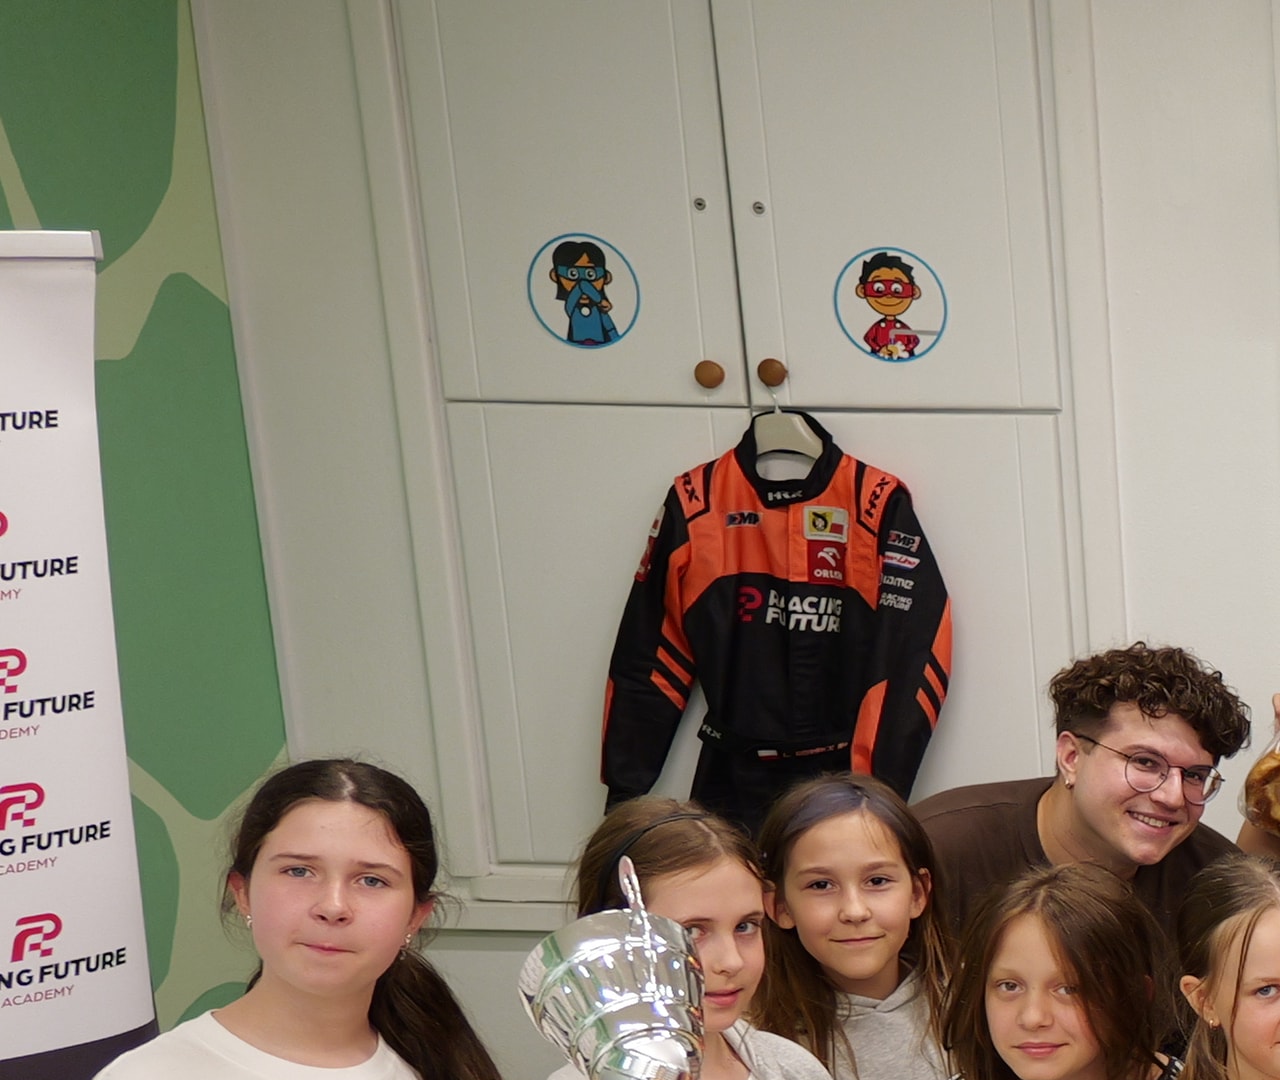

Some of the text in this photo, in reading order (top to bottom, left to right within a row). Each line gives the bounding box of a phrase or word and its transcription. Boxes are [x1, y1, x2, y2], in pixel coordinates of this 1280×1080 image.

[3, 691, 96, 721] FUTURE
[21, 820, 111, 854] FUTURE
[38, 947, 127, 984] FUTURE
[1, 985, 75, 1009] ACADEMY
